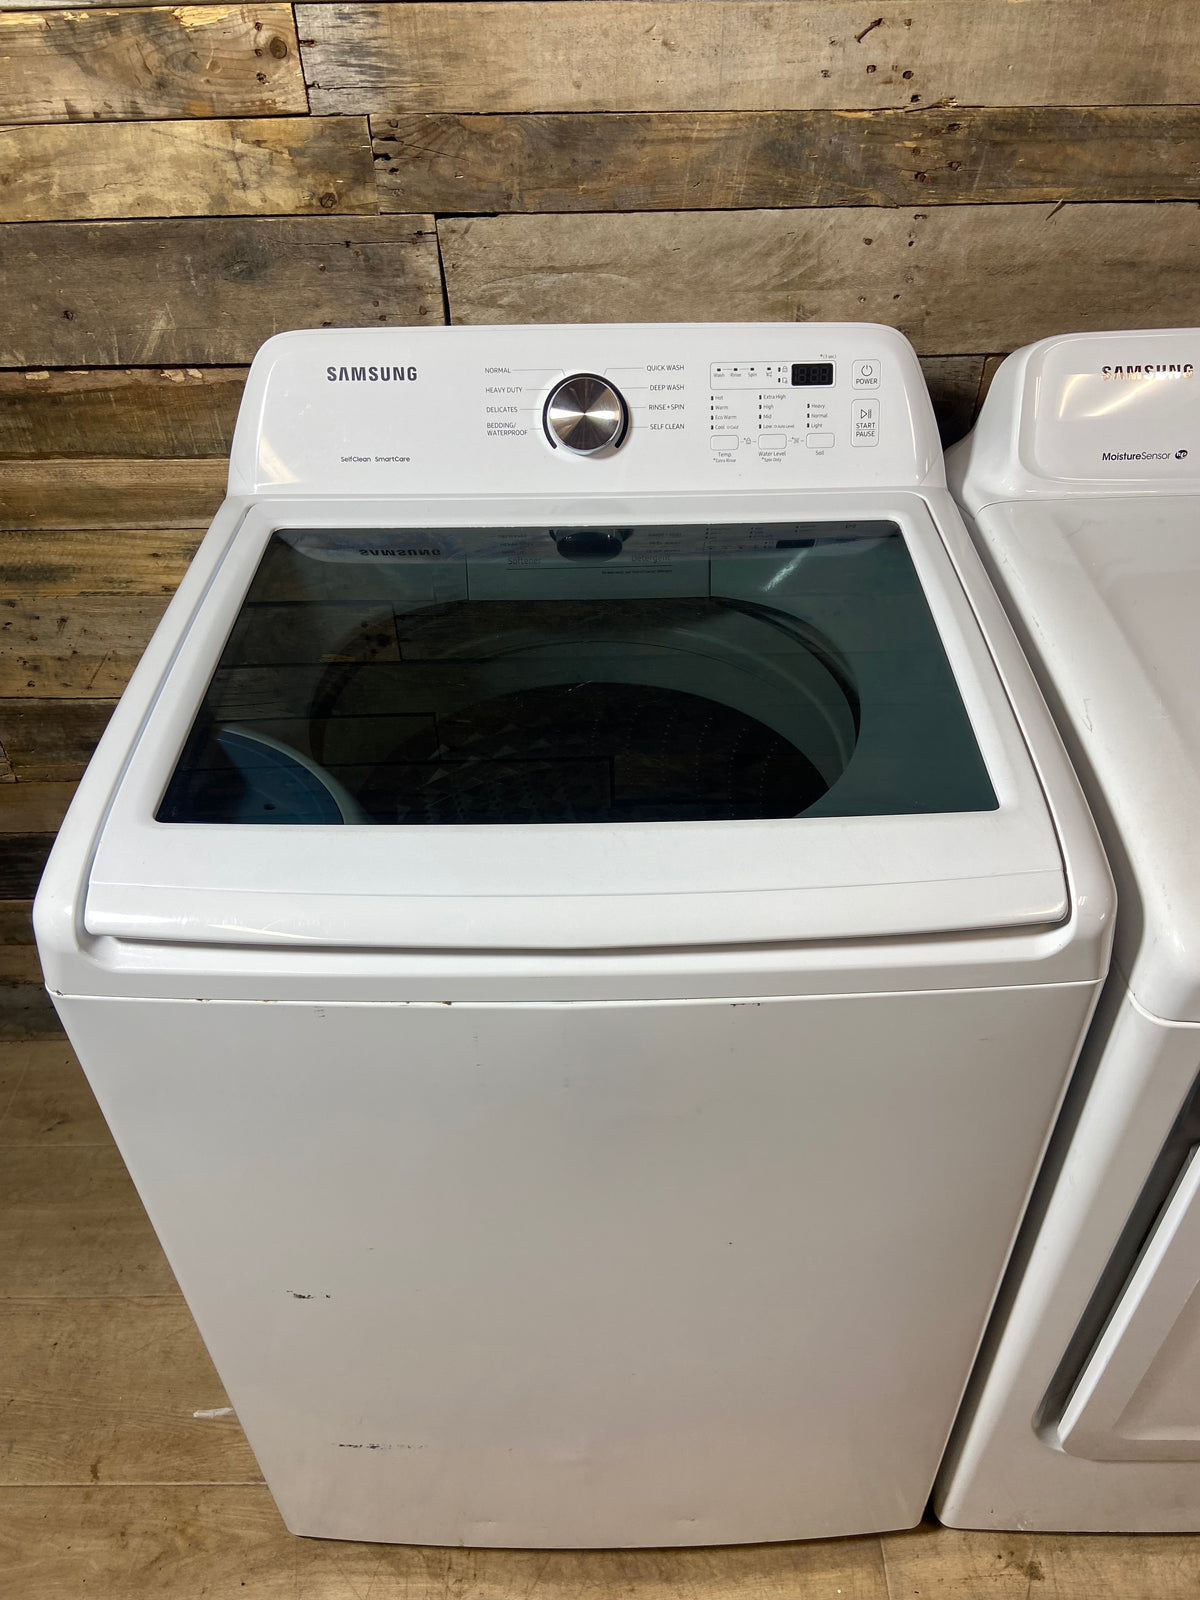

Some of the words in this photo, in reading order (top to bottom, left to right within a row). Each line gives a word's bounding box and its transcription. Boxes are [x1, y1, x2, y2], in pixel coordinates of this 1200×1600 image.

[326, 366, 418, 382] SAMSUNG
[1101, 364, 1194, 381] SAMSUNG
[340, 455, 372, 463] SelfClean
[374, 455, 411, 463] SmartCare
[507, 557, 542, 565] Softener
